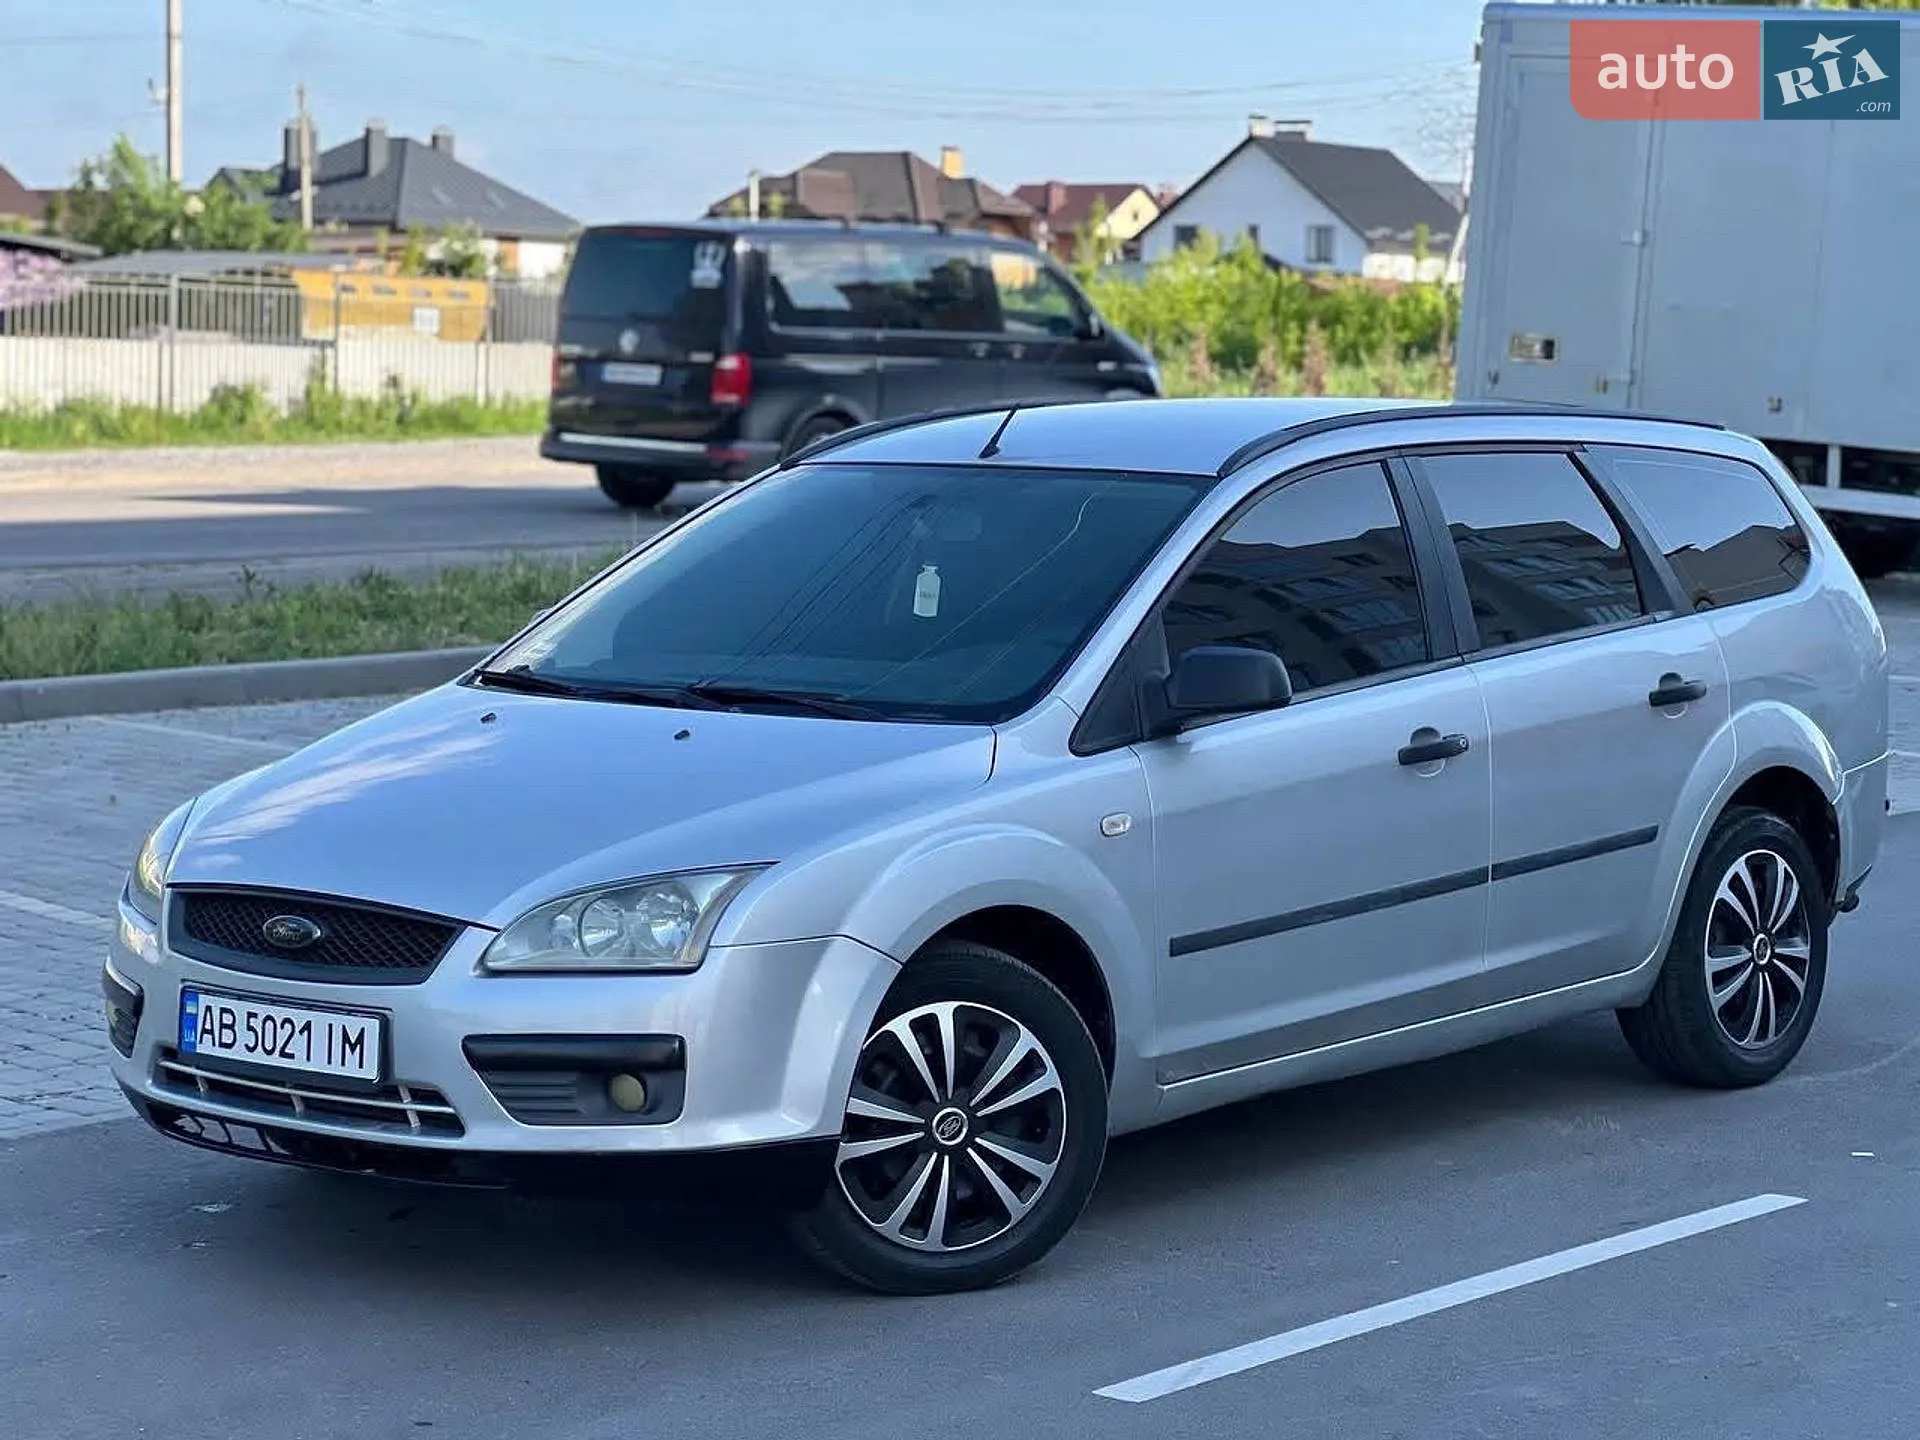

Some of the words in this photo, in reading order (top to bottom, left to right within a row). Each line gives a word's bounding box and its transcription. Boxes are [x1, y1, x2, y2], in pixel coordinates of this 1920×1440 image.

[184, 1029, 195, 1043] UA
[199, 1005, 237, 1049] AB
[244, 1011, 312, 1062] 5021
[327, 1023, 365, 1069] IM
